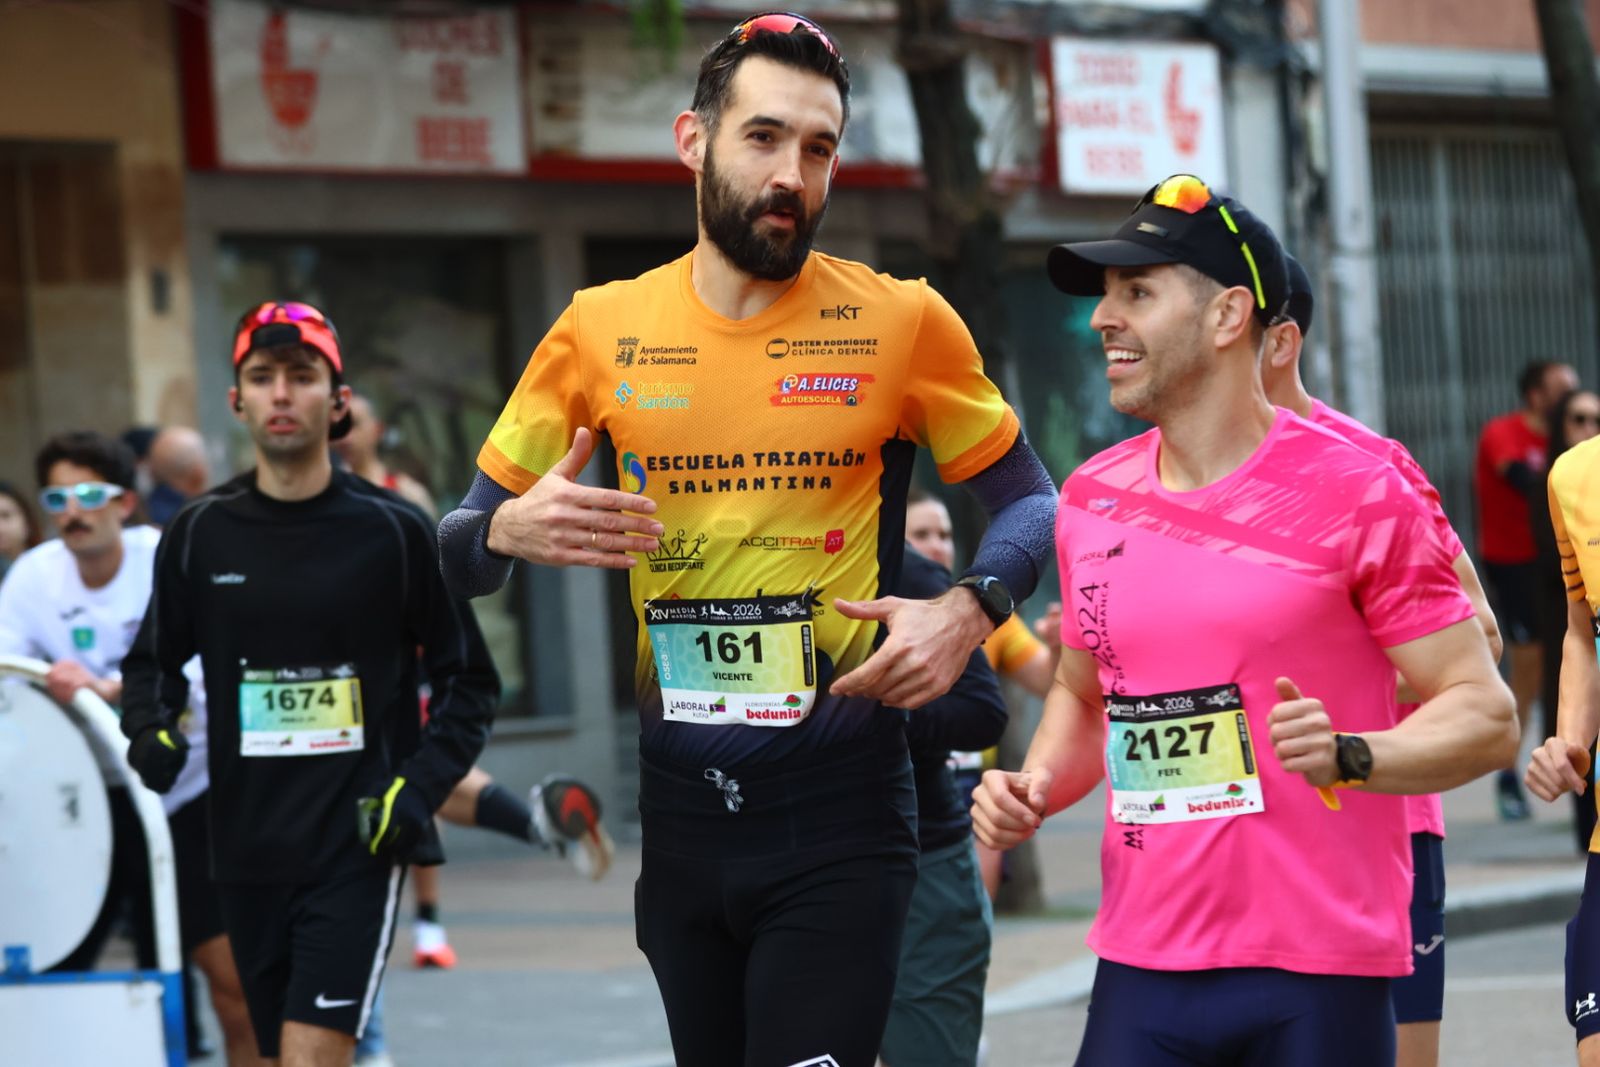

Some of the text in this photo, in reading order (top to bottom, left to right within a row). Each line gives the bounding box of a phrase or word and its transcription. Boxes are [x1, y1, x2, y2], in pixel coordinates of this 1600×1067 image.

[824, 338, 878, 346] RODRÍGUEZ
[640, 346, 698, 356] Ayuntamiento
[792, 347, 877, 356] CLÍNICA DENTAL
[638, 356, 697, 365] de Salamanca
[813, 377, 858, 391] ELICES
[781, 395, 841, 404] AUTOESCUELA
[646, 448, 866, 472] ESCUELA TRIATLÓN
[669, 476, 832, 494] SALMANTINA
[738, 535, 842, 548] ACCITRAF AT
[650, 608, 669, 620] XIV
[732, 604, 762, 616] 2026
[1079, 582, 1114, 669] 2024
[696, 631, 763, 664] 161
[713, 672, 753, 681] VICENTE
[263, 686, 336, 711] 1674
[1163, 696, 1195, 710] 2026
[671, 701, 708, 712] LABORAL
[1123, 721, 1215, 761] 2127
[1158, 768, 1182, 777] FEFE
